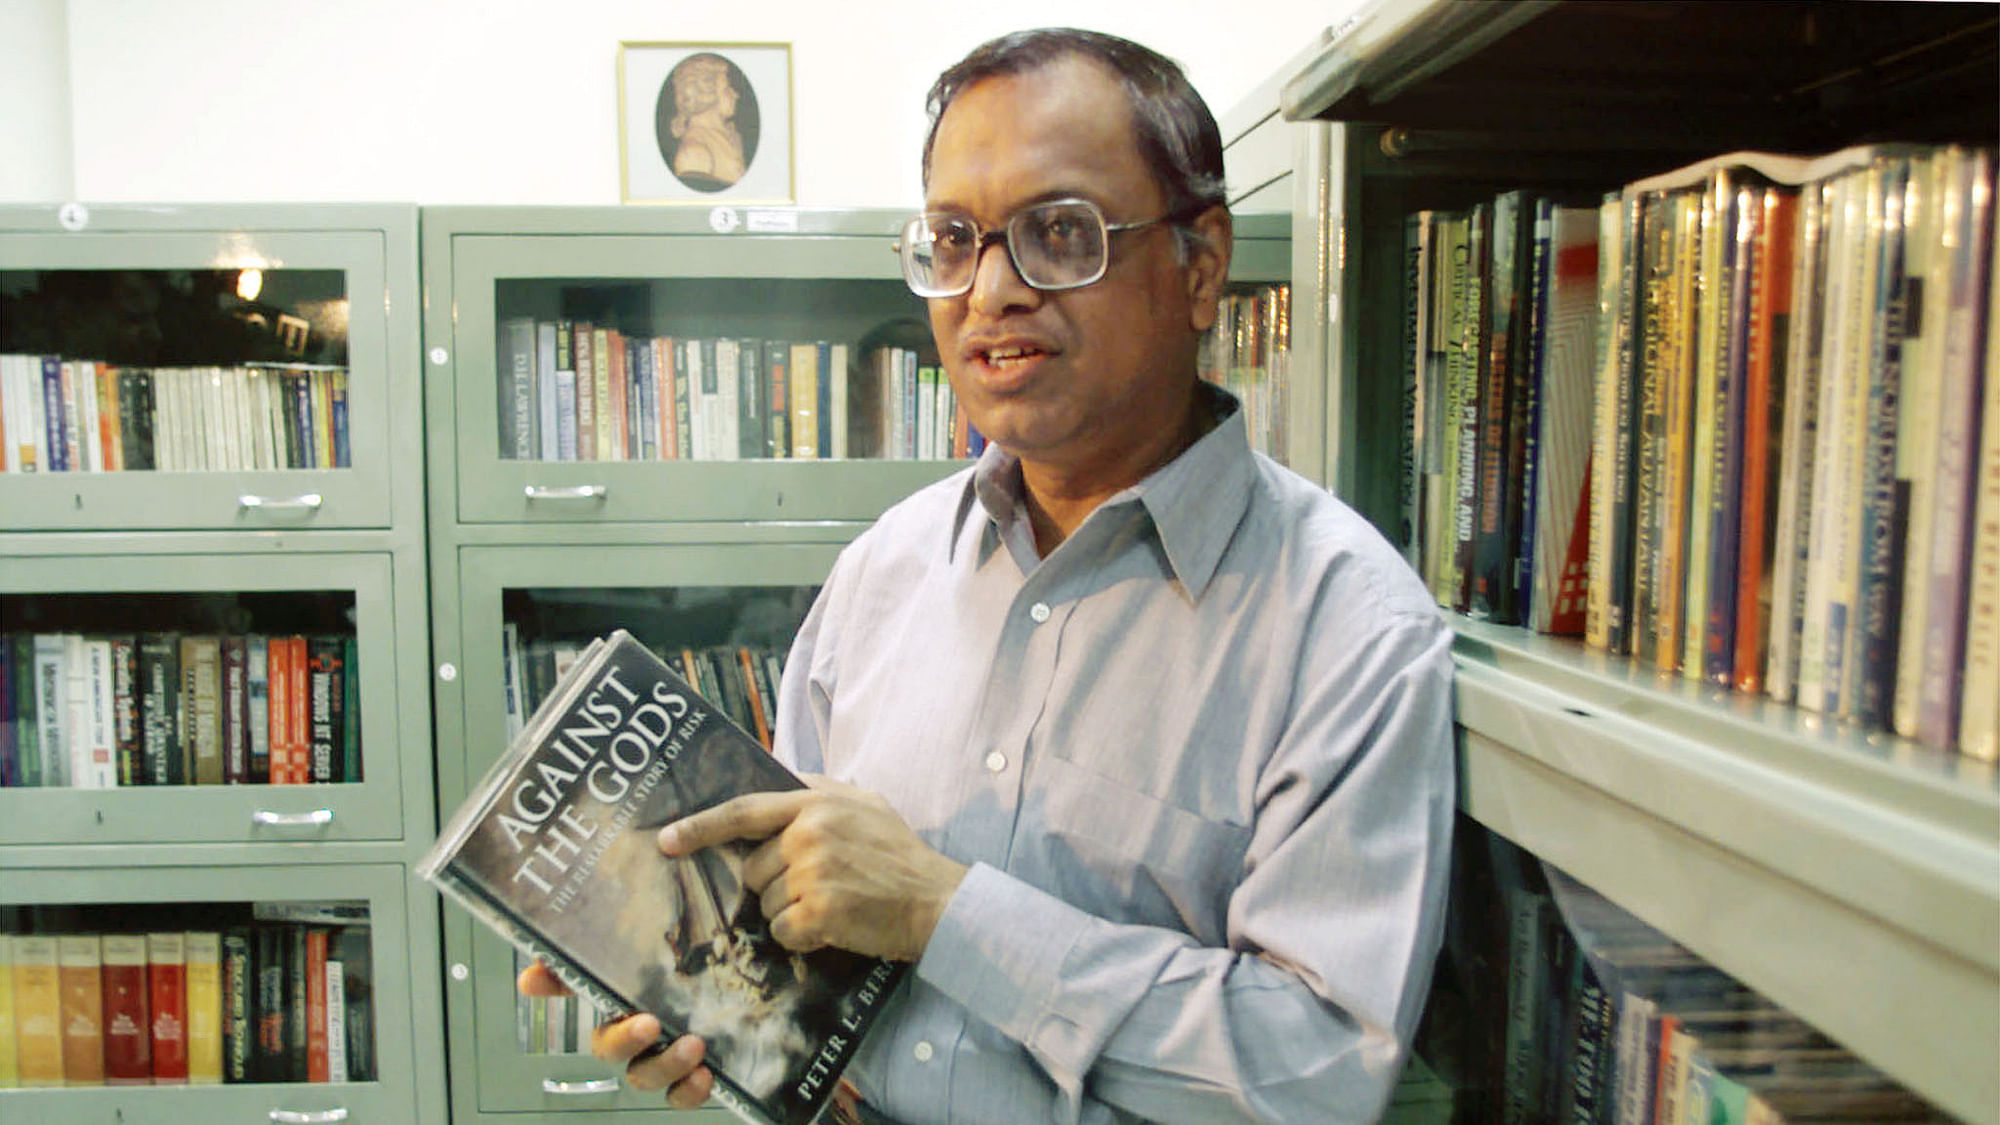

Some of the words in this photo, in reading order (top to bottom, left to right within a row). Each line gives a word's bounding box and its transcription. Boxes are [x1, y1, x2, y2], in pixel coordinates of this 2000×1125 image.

[1407, 244, 1422, 377] INVESTMENT
[1447, 341, 1463, 427] THINKING
[1617, 348, 1632, 426] PROBLEM
[1459, 406, 1476, 501] PLANNING,
[1486, 424, 1502, 447] OF
[1615, 432, 1629, 503] SOLVING
[1876, 362, 1902, 575] NORDSTROM
[1458, 504, 1473, 542] AND
[1869, 581, 1888, 637] WAY
[313, 743, 332, 780] SERVER
[495, 664, 640, 853] AGAINST
[512, 804, 599, 898] THE
[586, 681, 688, 805] GODS
[546, 879, 578, 915] THE
[570, 799, 638, 887] REMARKABLE
[633, 757, 670, 801] STORY
[665, 739, 683, 760] OF
[679, 706, 708, 739] RISK
[794, 1032, 848, 1101] PETER
[840, 1009, 862, 1031] L.
